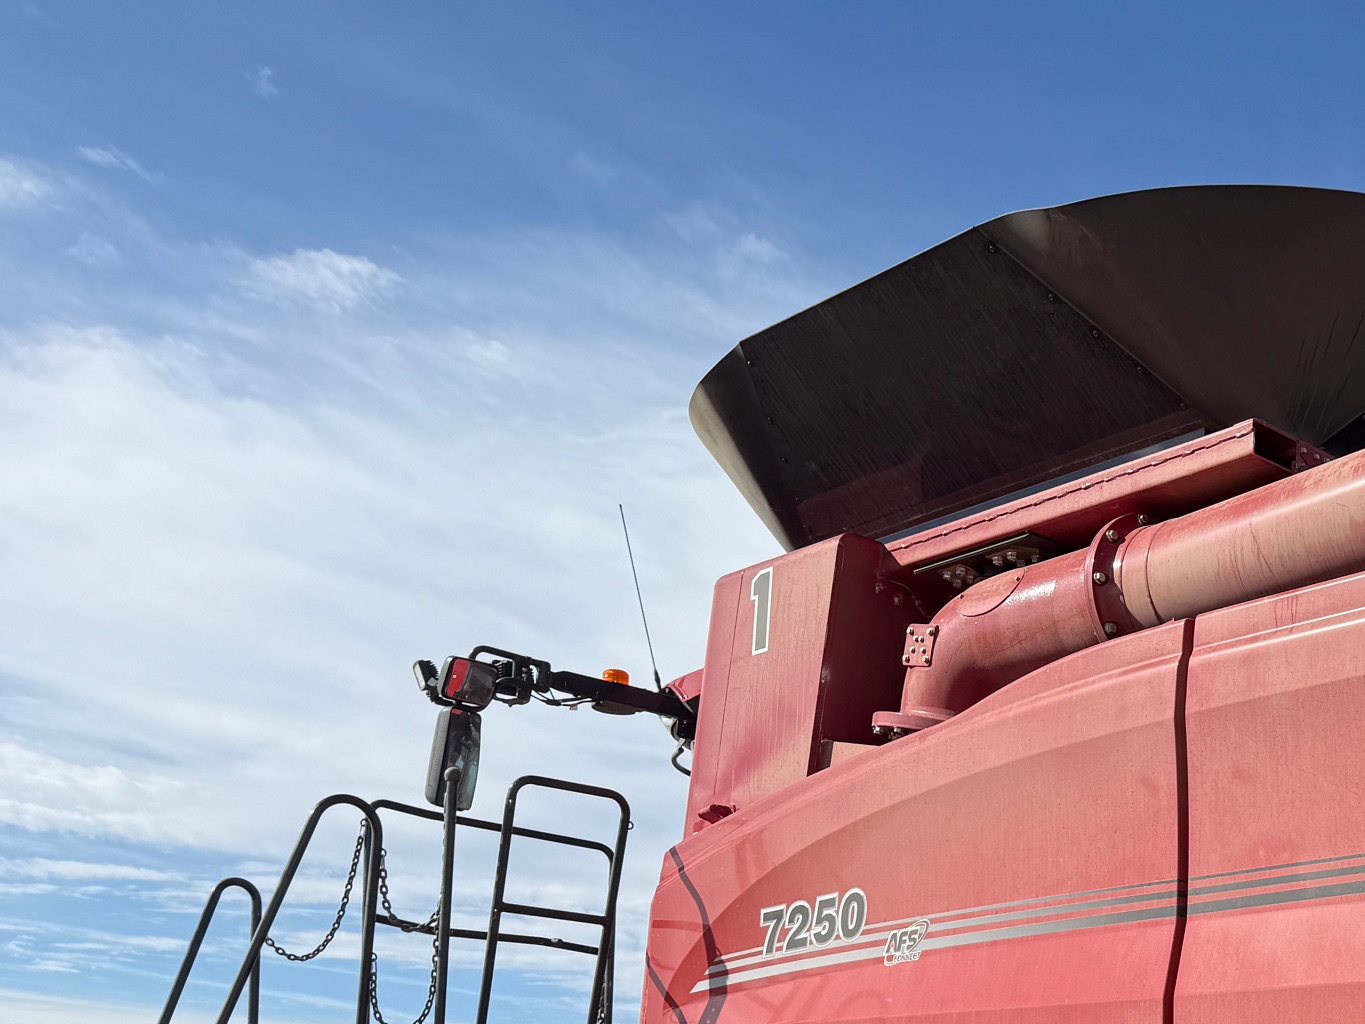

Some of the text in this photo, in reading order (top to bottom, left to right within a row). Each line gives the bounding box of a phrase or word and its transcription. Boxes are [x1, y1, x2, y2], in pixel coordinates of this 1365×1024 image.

[750, 566, 773, 656] 1
[760, 887, 868, 959] 7250
[884, 927, 920, 955] AFS
